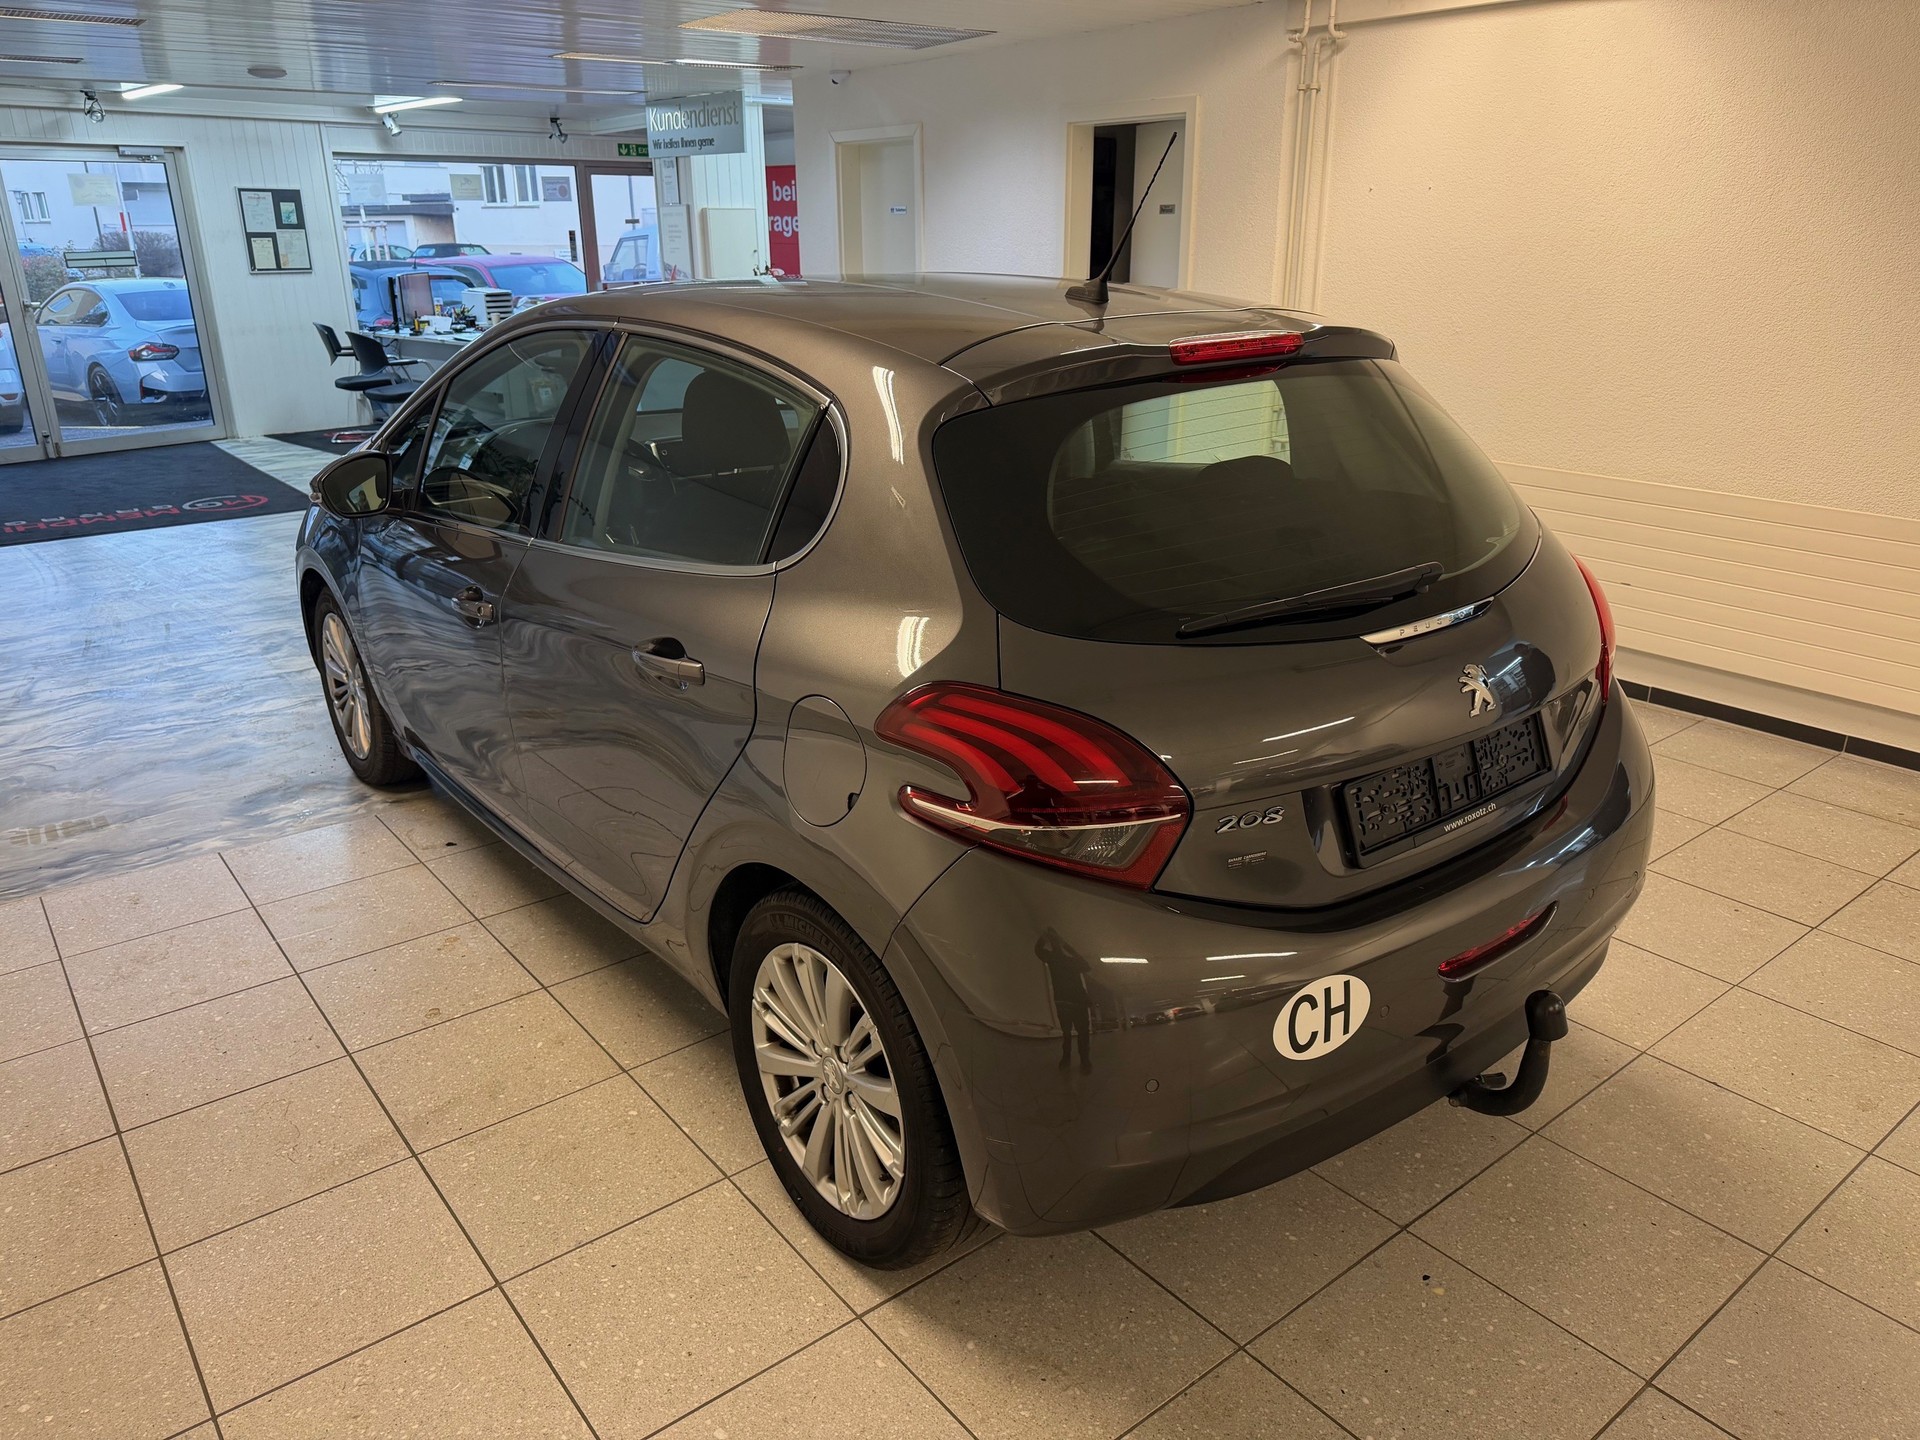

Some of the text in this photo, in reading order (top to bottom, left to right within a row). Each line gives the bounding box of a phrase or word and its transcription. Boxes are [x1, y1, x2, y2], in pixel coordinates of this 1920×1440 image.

[649, 102, 739, 131] Kundendienst
[653, 137, 715, 150] Wir helfen Ihnen gerne
[772, 180, 796, 202] bei
[1399, 604, 1476, 637] PEUGEOT
[1215, 806, 1285, 834] 208
[1443, 802, 1497, 832] www.roxotz.ch
[1288, 979, 1351, 1054] CH
